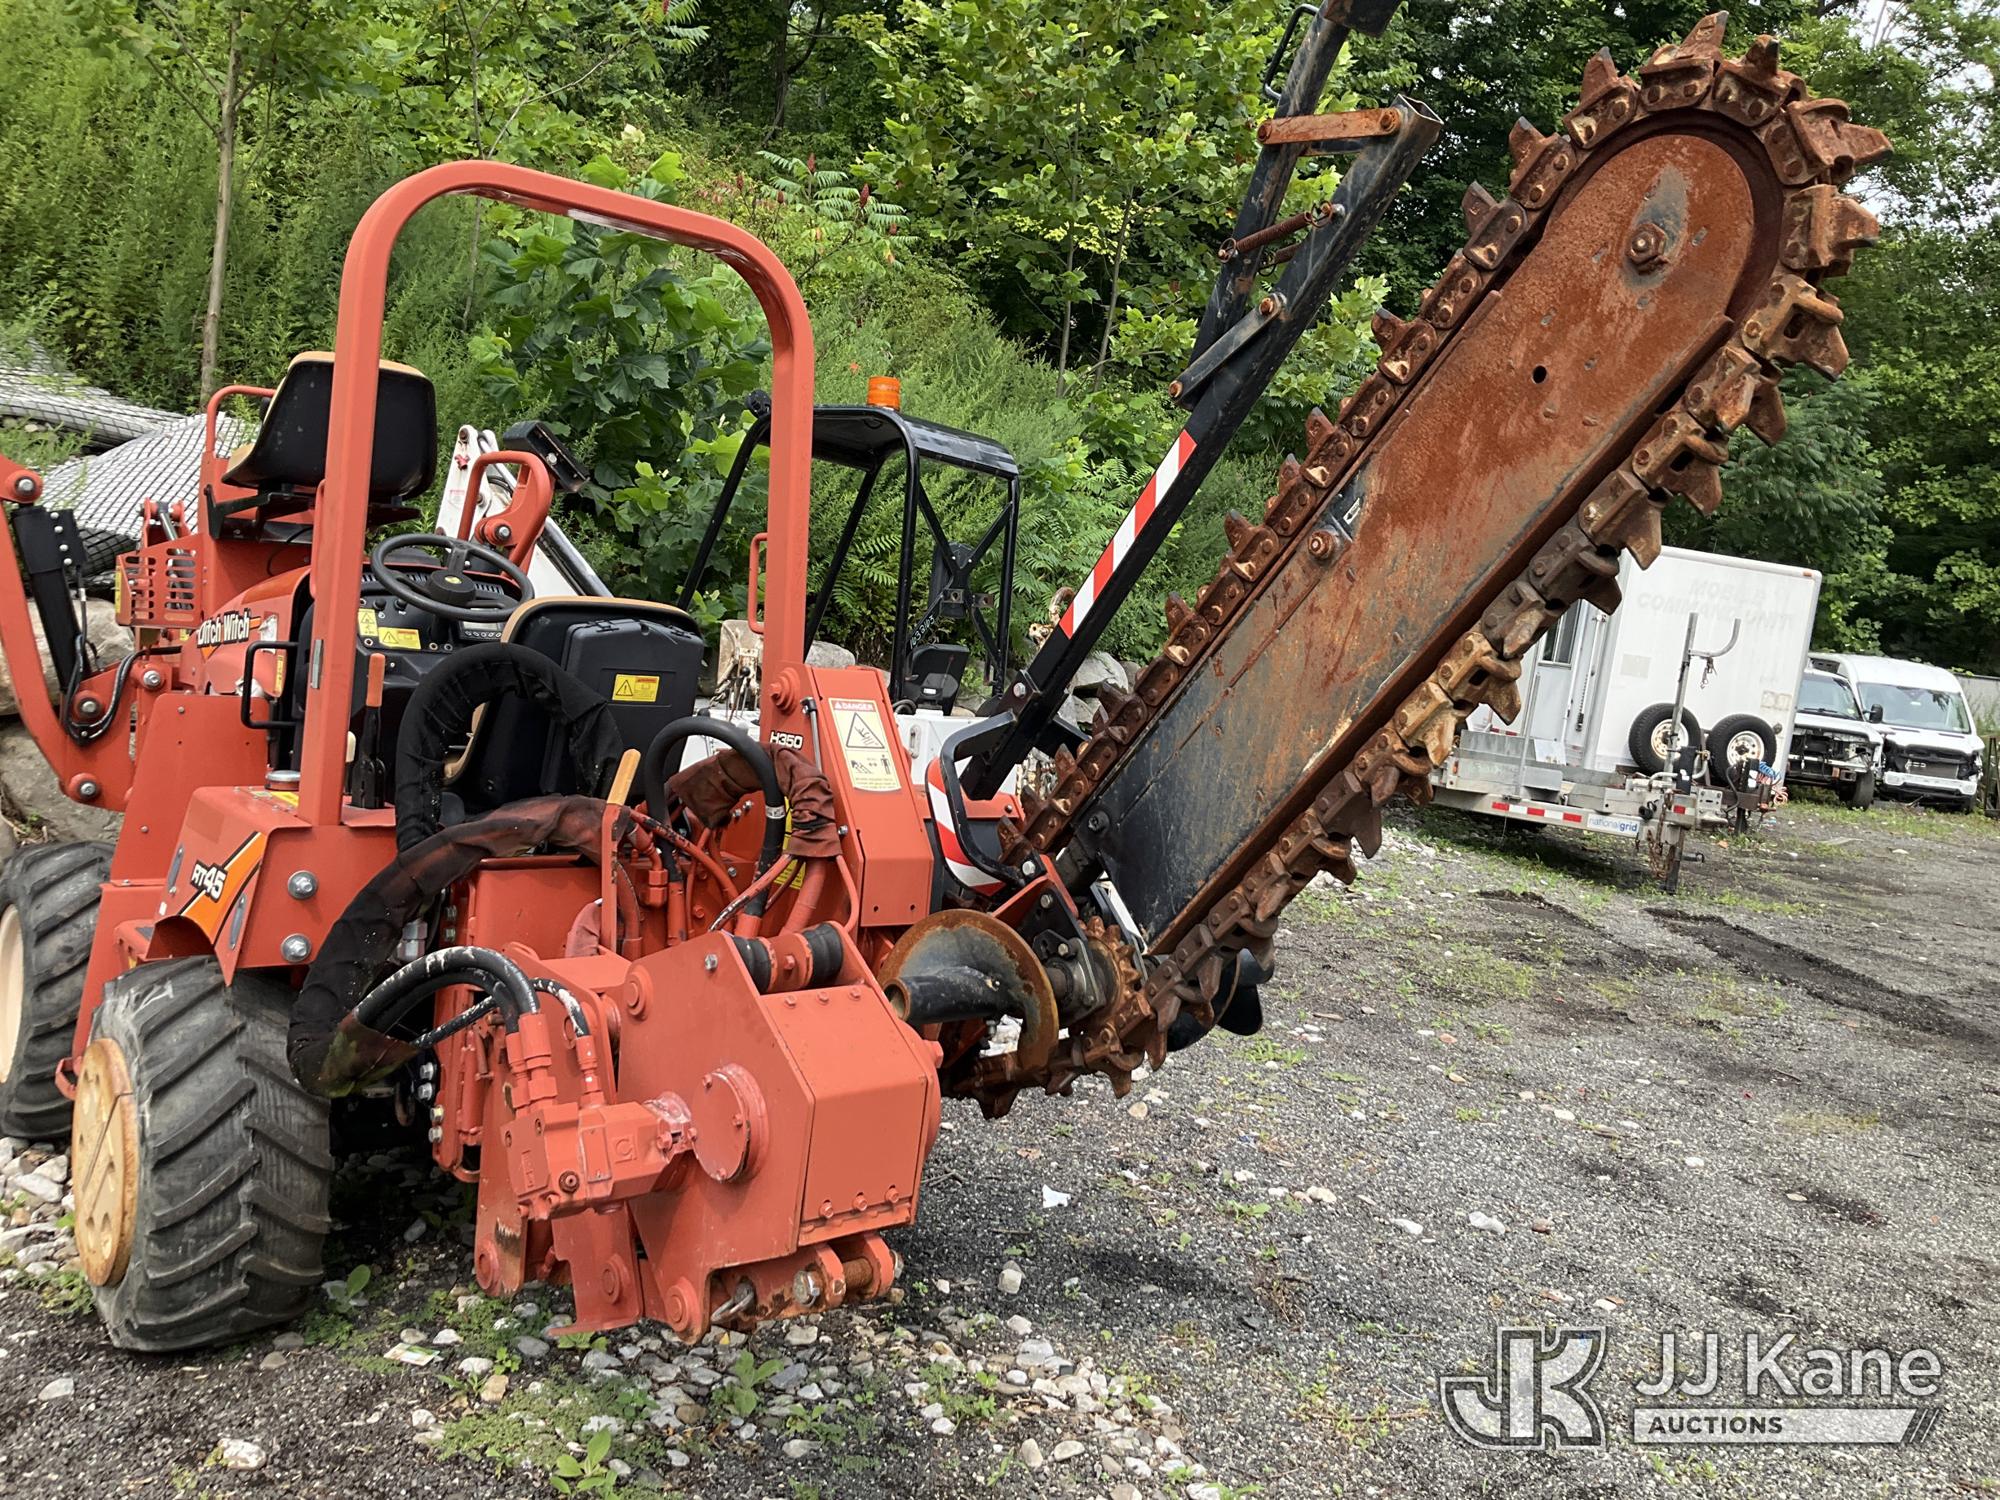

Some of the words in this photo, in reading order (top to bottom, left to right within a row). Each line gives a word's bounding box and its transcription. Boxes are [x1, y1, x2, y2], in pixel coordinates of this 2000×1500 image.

[222, 608, 250, 643] Witch
[769, 731, 804, 749] H350
[191, 862, 227, 900] RT45
